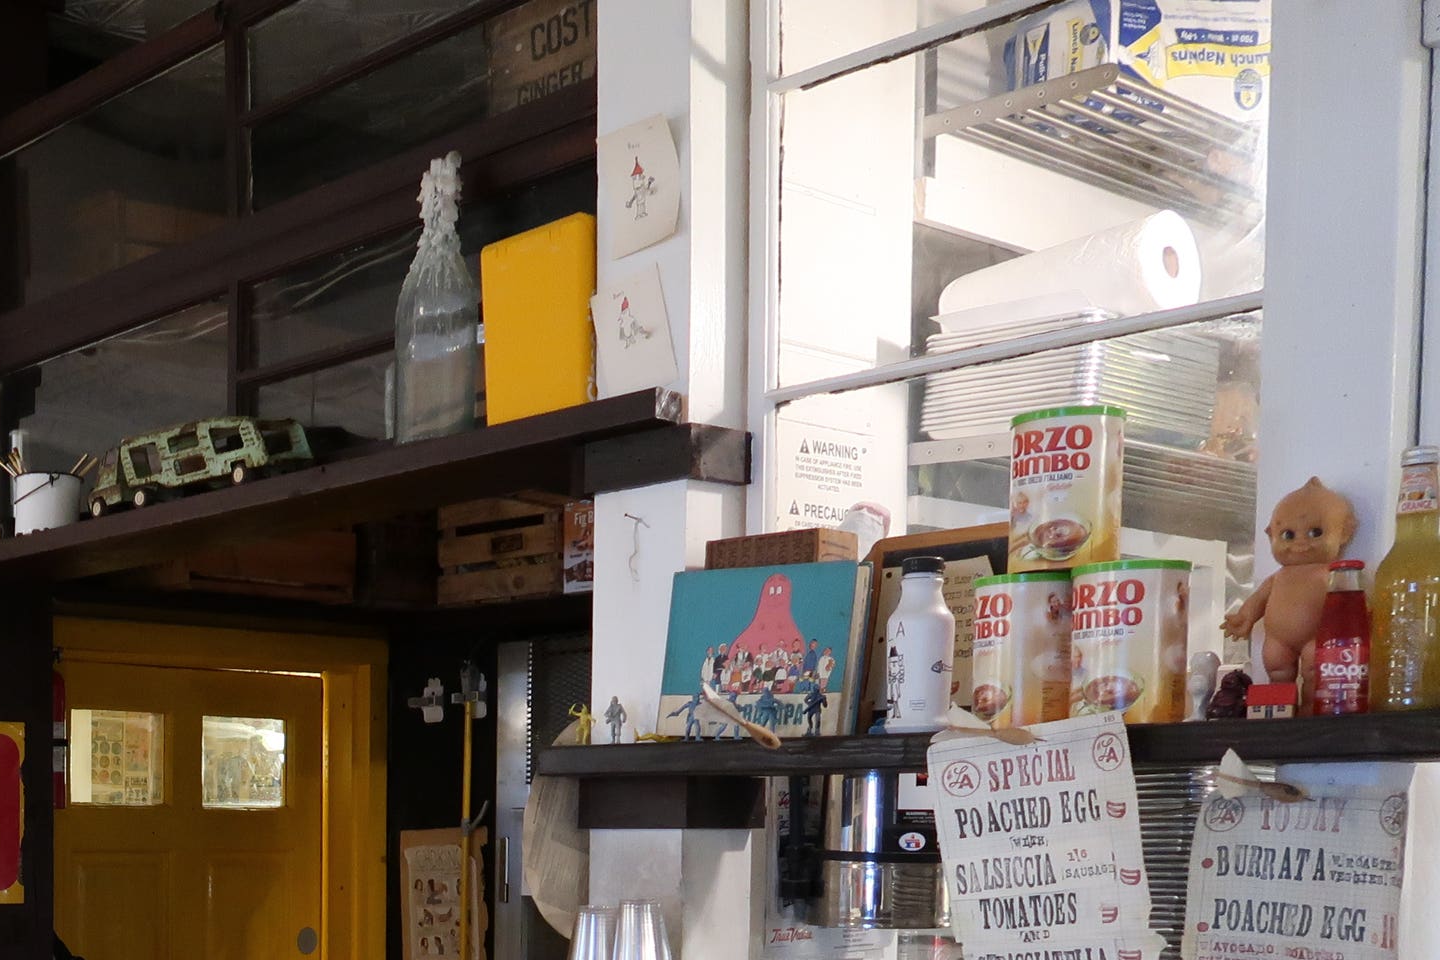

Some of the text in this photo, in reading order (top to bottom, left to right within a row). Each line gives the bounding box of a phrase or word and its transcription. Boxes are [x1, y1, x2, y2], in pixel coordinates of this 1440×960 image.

[812, 440, 858, 461] WARNING
[975, 592, 1013, 620] ZO
[987, 749, 1076, 793] SPECIAL
[954, 787, 1102, 840] POACHED EGG
[955, 853, 1057, 896] SALSICCIA
[1216, 844, 1326, 881] BURRATA
[979, 892, 1078, 930] TOMATOES
[1211, 898, 1313, 938] POACHED
[1320, 905, 1367, 942] EGG
[1022, 929, 1050, 943] AND
